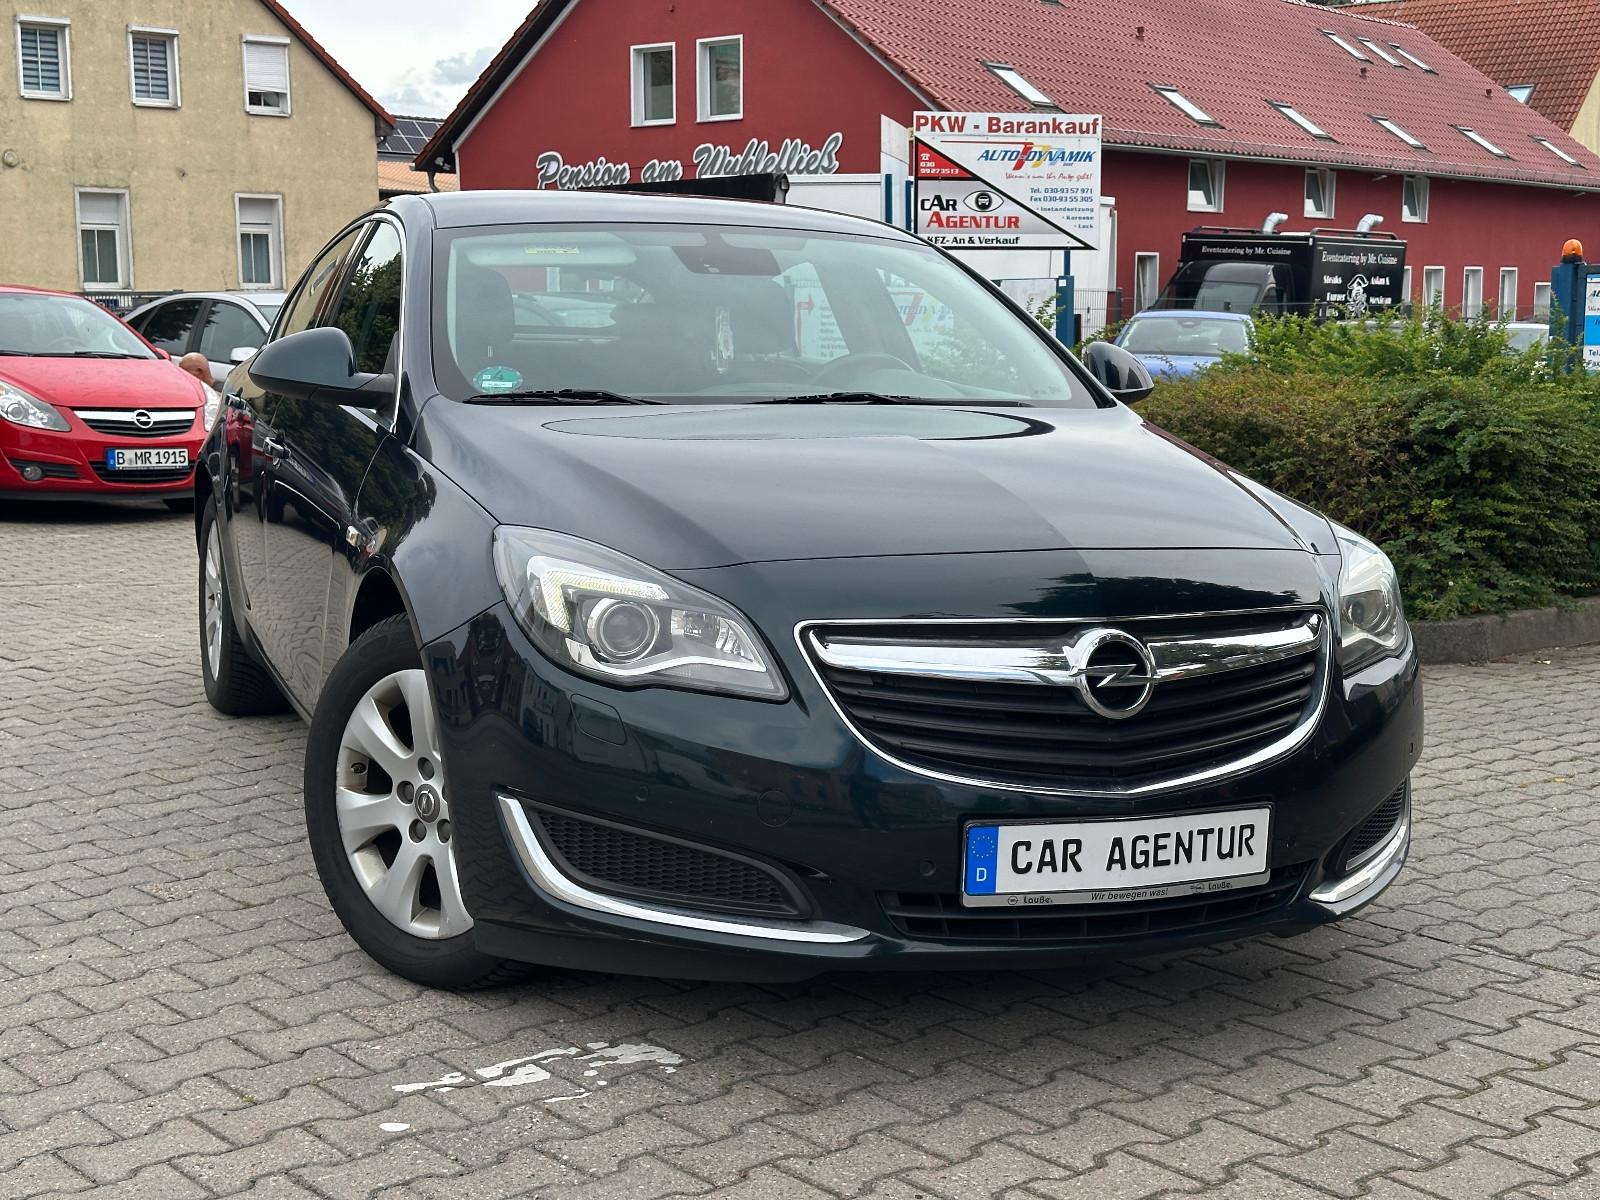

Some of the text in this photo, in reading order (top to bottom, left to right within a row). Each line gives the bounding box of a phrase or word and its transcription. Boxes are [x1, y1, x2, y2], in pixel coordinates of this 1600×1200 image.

[915, 115, 967, 133] PKW
[987, 116, 1099, 135] Barankauf
[536, 150, 630, 190] Pension
[641, 159, 683, 184] am
[1080, 195, 1093, 203] 305
[926, 211, 1020, 229] AGENTUR
[951, 236, 966, 245] An
[967, 236, 977, 245] &
[978, 236, 1020, 245] Verkauf
[1201, 245, 1292, 256] Eventcatering by Mr. Cuisine
[1321, 251, 1398, 266] Eventcatering by Mr. Cuisine
[116, 450, 187, 465] B MR 1915
[1010, 823, 1255, 875] CAR AGENTUR
[975, 867, 987, 882] D
[1090, 886, 1169, 902] Wir bewegen was!
